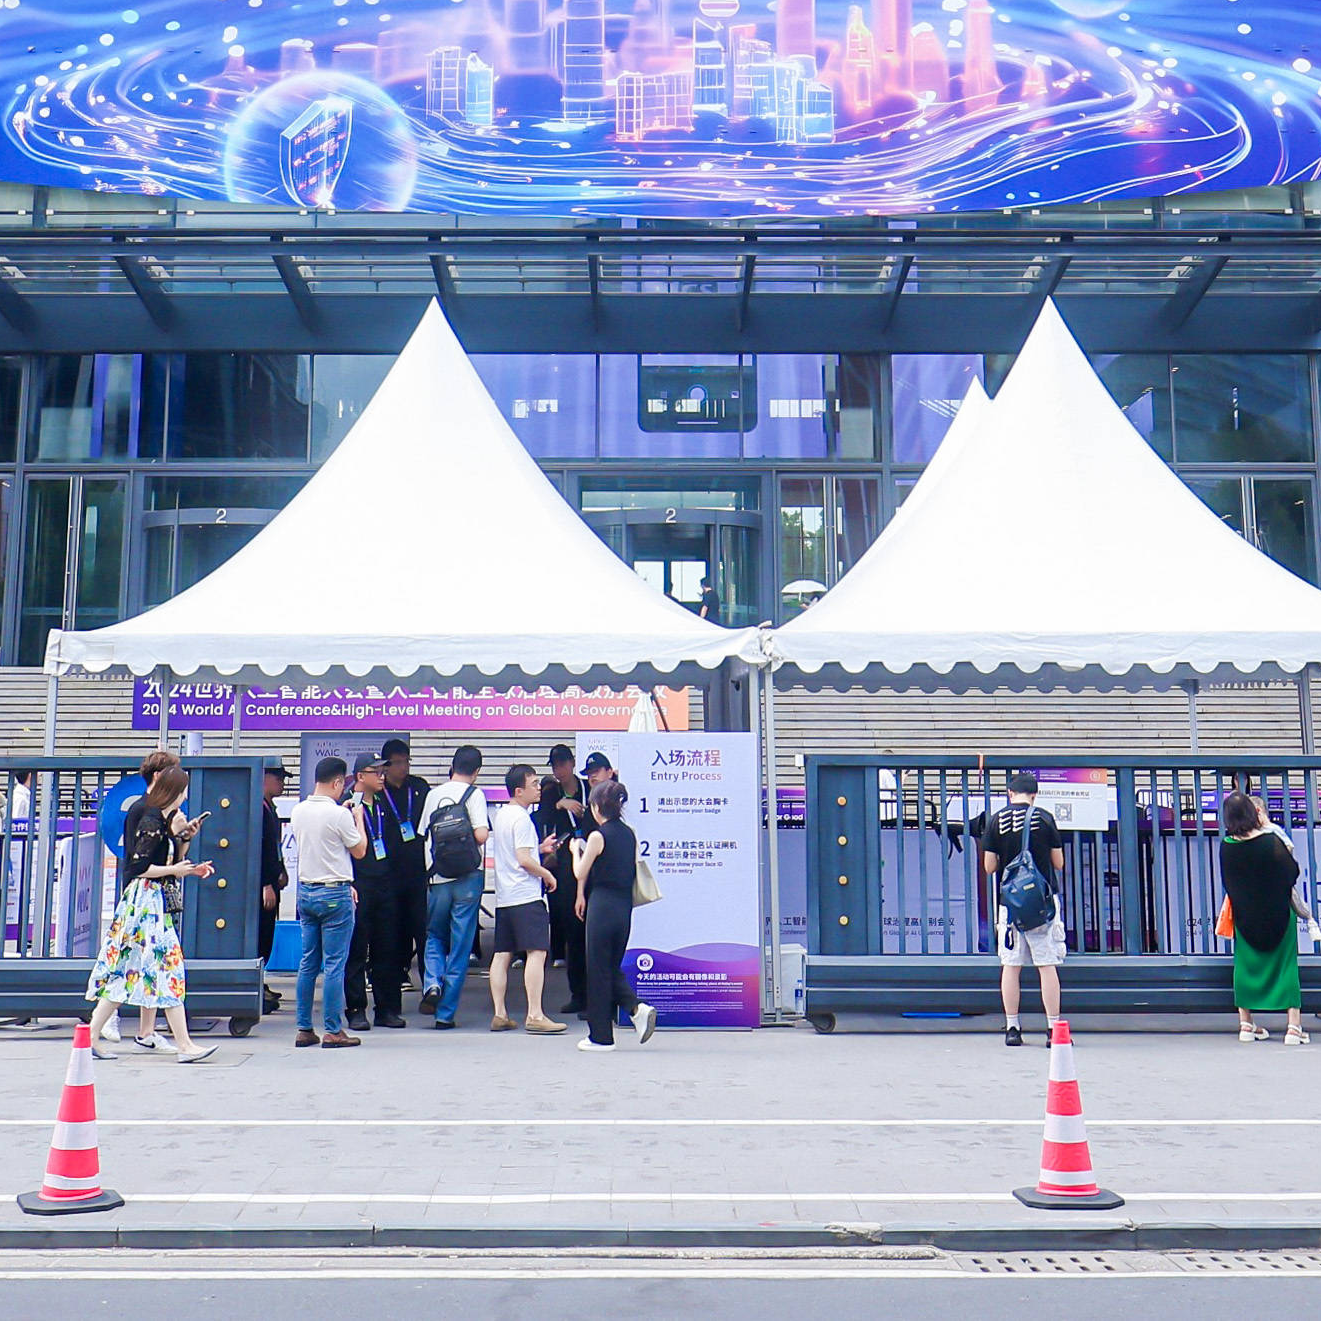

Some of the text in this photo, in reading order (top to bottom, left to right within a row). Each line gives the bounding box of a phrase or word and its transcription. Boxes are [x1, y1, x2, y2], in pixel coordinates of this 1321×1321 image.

[215, 508, 227, 524] 2
[665, 507, 677, 524] 2
[142, 703, 177, 716] 204
[181, 703, 224, 716] World
[245, 703, 419, 720] Conference&High-Level
[423, 703, 482, 720] Meeting
[485, 706, 504, 716] on
[508, 703, 556, 716] Global
[560, 704, 575, 716] AI
[651, 749, 721, 767] 入场流程
[650, 771, 722, 783] Entry Process
[639, 797, 649, 813] 1
[640, 840, 650, 857] 2
